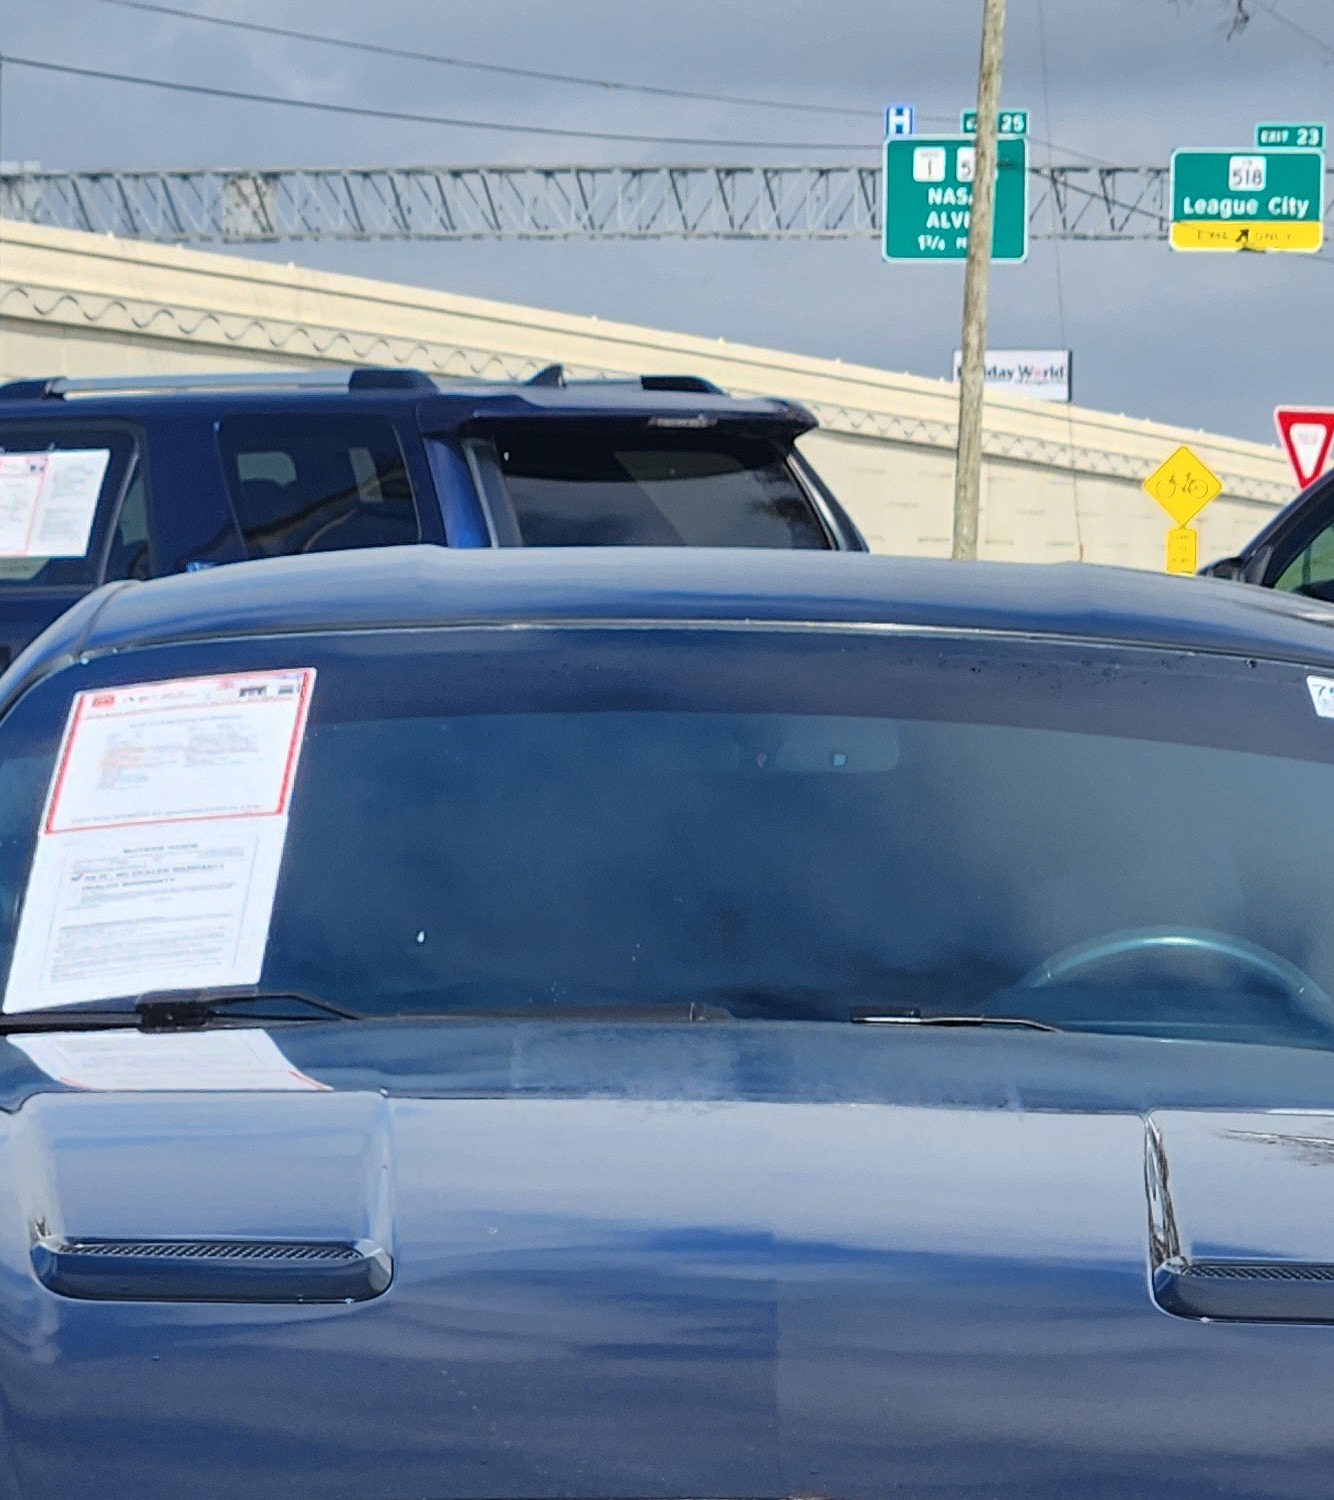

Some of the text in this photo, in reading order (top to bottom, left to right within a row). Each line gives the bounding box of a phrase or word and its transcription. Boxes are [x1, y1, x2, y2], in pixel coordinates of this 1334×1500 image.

[1296, 127, 1320, 146] 23
[1232, 168, 1263, 186] 518
[1182, 195, 1310, 219] League City
[925, 210, 971, 230] ALVI
[1017, 365, 1064, 379] World
